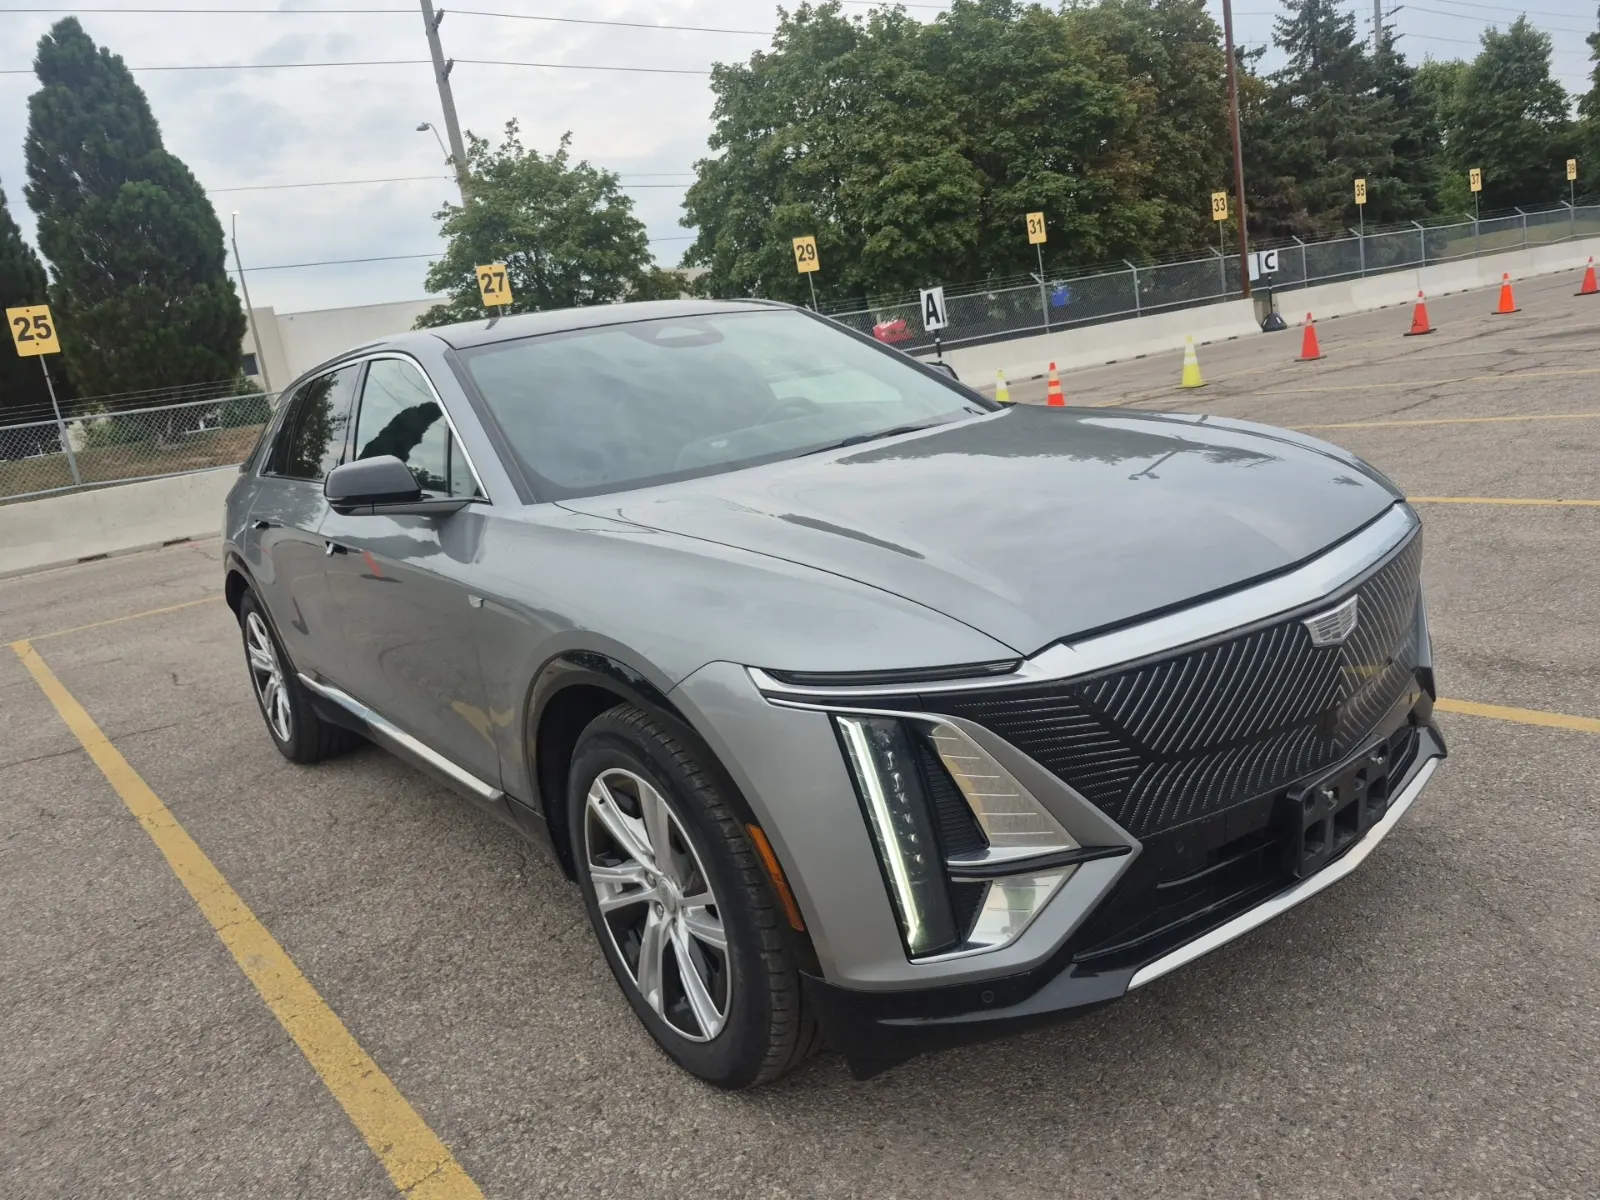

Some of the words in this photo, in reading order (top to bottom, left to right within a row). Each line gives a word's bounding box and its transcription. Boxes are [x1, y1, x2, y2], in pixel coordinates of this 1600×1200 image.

[1471, 173, 1480, 184] 37
[1356, 184, 1365, 197] 35
[1213, 198, 1226, 212] 33
[1028, 218, 1043, 236] 31
[797, 243, 816, 262] 29
[1264, 252, 1276, 270] C
[480, 272, 505, 294] 27
[925, 293, 941, 326] A
[12, 315, 53, 341] 25
